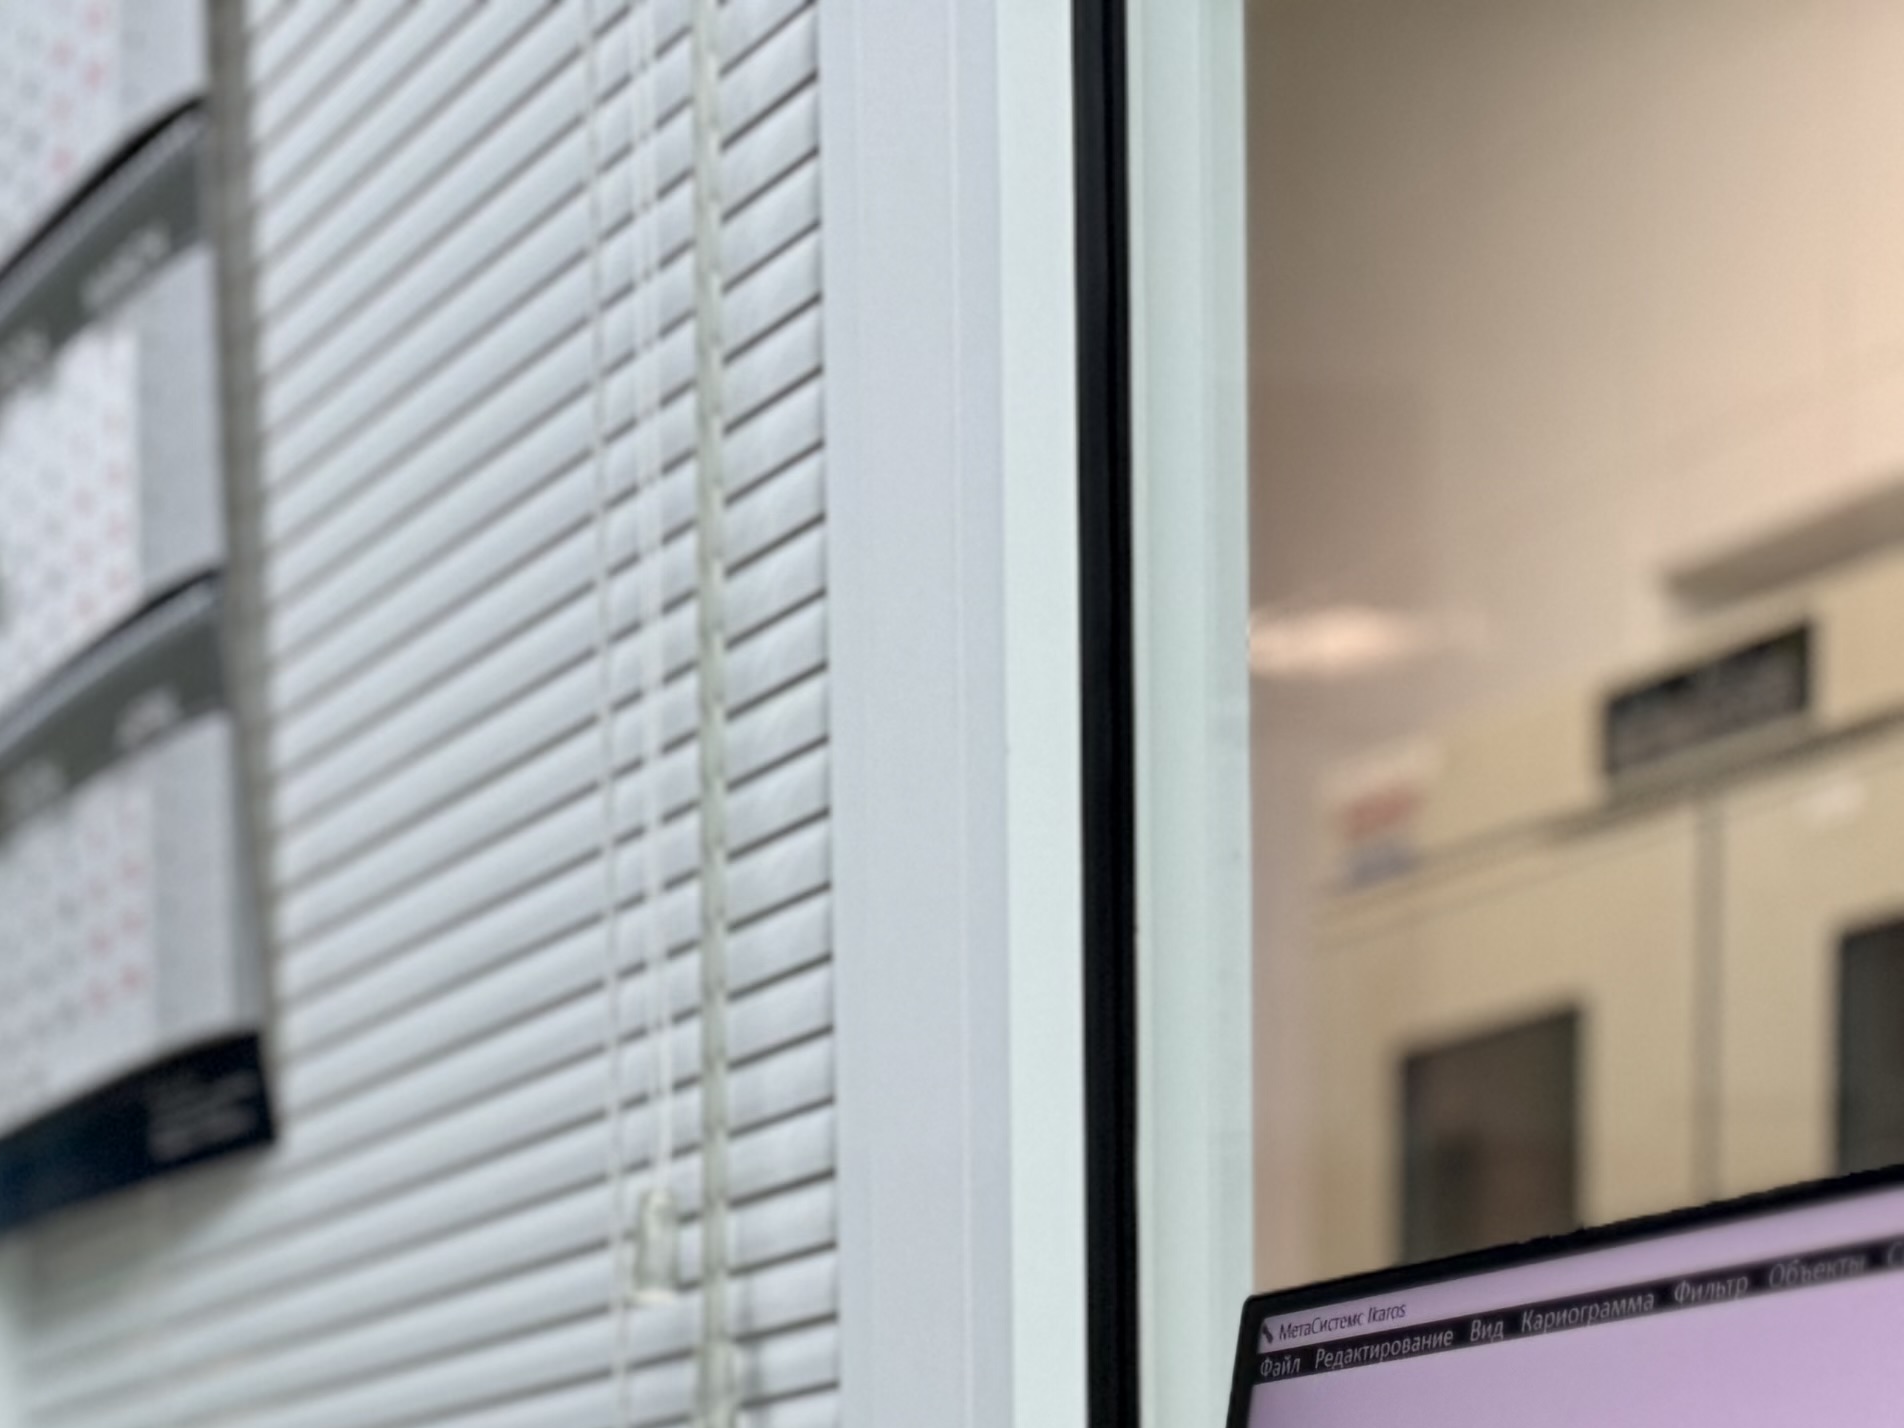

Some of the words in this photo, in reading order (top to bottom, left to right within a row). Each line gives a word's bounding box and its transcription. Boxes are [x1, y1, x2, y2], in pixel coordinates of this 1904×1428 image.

[1259, 1354, 1301, 1378] Файл
[1314, 1329, 1454, 1369] Редактирование
[1470, 1318, 1505, 1342] Вид
[1521, 1291, 1655, 1334] Кариограмма
[1674, 1274, 1748, 1304] Фильтр
[1768, 1254, 1866, 1288] Объекты
